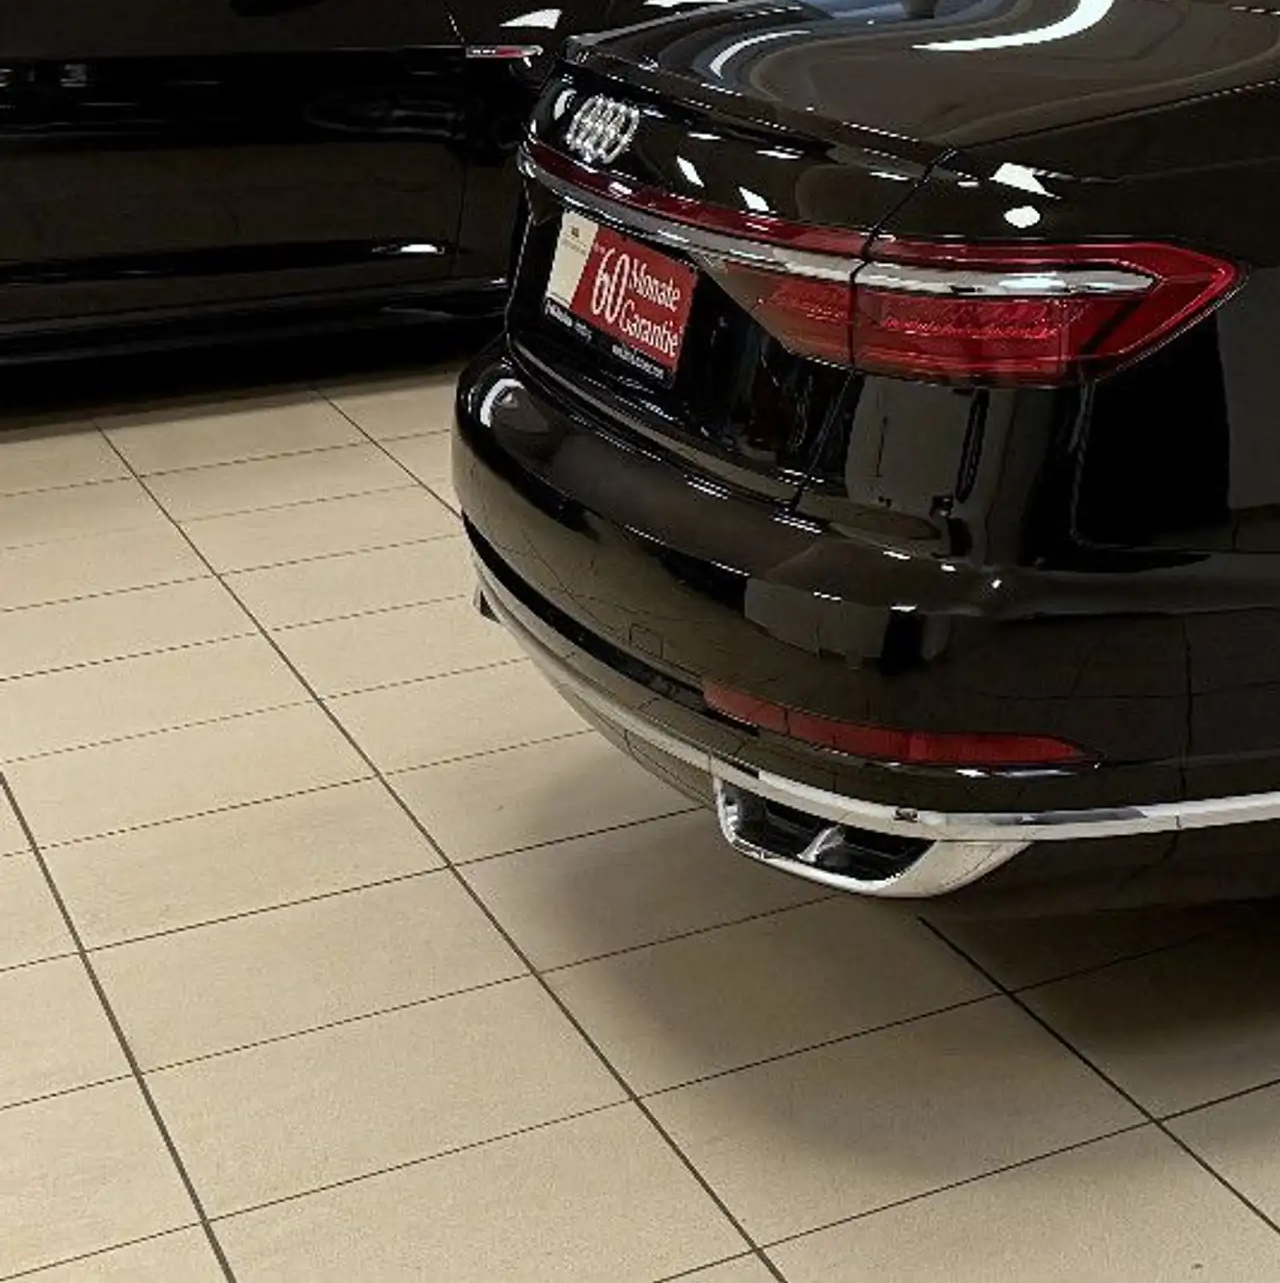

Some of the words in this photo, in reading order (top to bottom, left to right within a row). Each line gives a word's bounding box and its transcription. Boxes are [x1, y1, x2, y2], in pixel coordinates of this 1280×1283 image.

[592, 247, 630, 322] 60
[630, 259, 681, 312] Monate
[618, 299, 679, 357] Garantie
